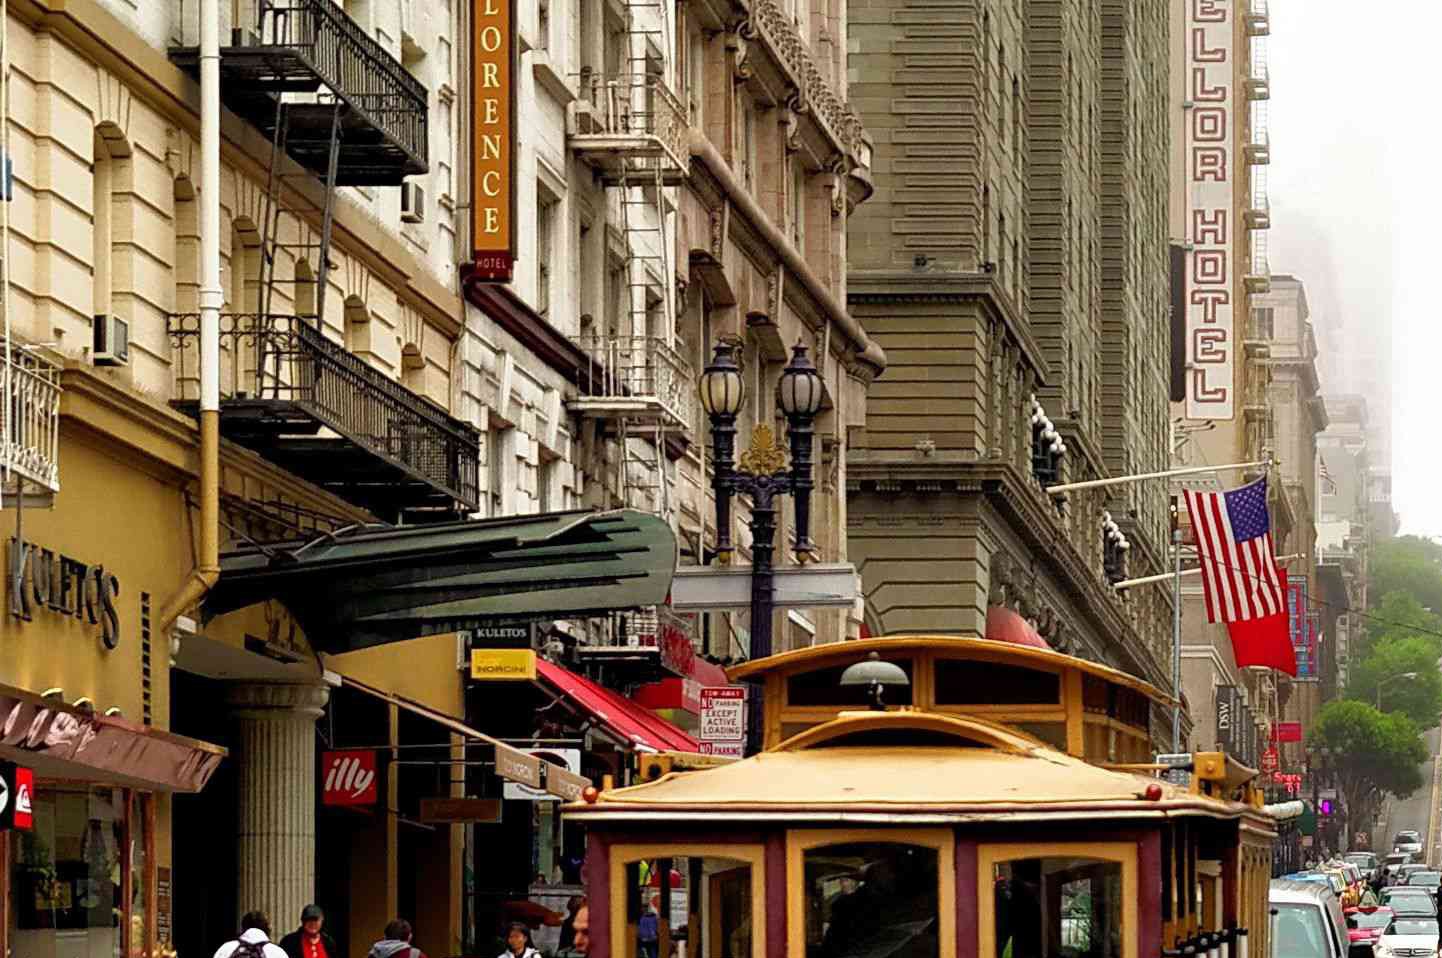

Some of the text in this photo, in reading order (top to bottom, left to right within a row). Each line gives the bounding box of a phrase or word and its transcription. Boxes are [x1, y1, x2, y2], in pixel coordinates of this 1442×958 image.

[480, 0, 501, 233] LORENCE
[477, 258, 506, 269] HOTEL
[1191, 209, 1229, 402] HOTEL
[1219, 703, 1229, 729] DSW
[325, 758, 375, 798] illy
